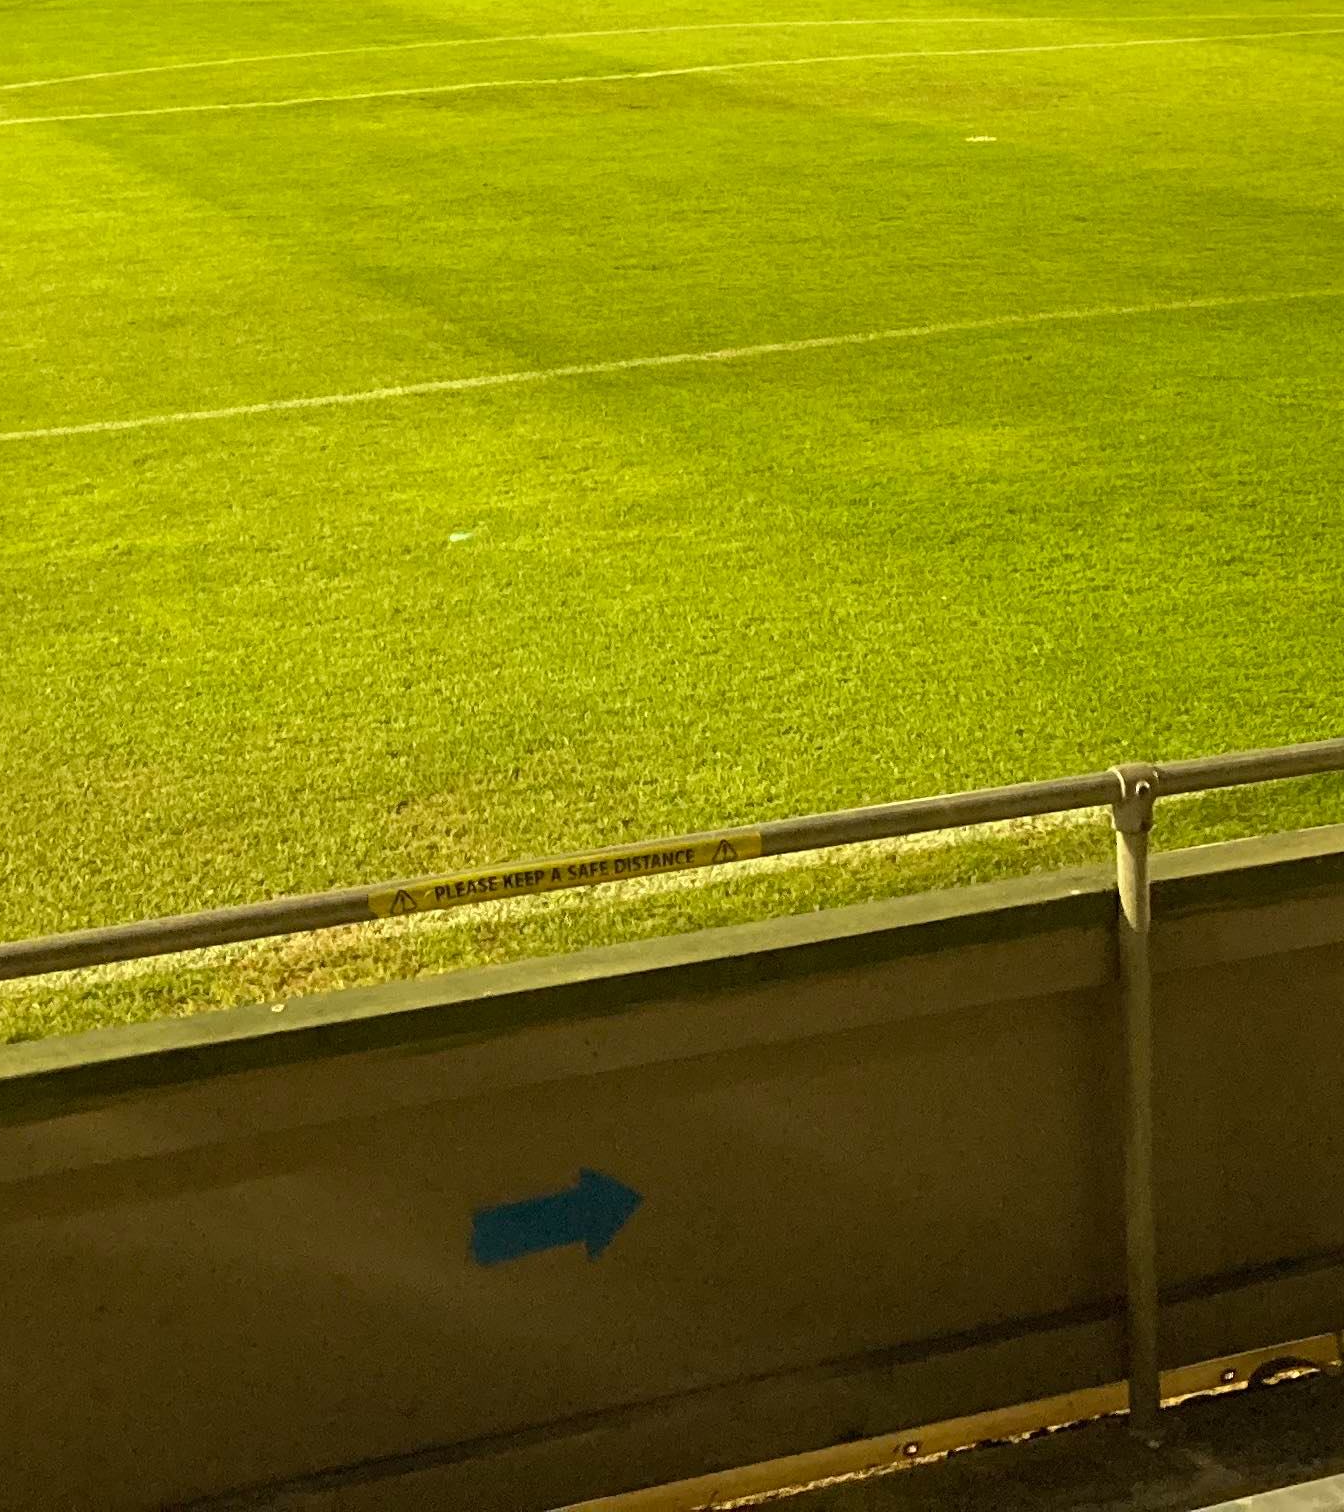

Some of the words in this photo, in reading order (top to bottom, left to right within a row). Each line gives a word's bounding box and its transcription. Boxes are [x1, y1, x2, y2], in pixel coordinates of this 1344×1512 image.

[435, 875, 498, 901] PLEASE
[503, 870, 545, 889] KEEP
[551, 867, 562, 882] A
[567, 861, 608, 880] SAFE
[614, 849, 695, 874] DISTANCE
